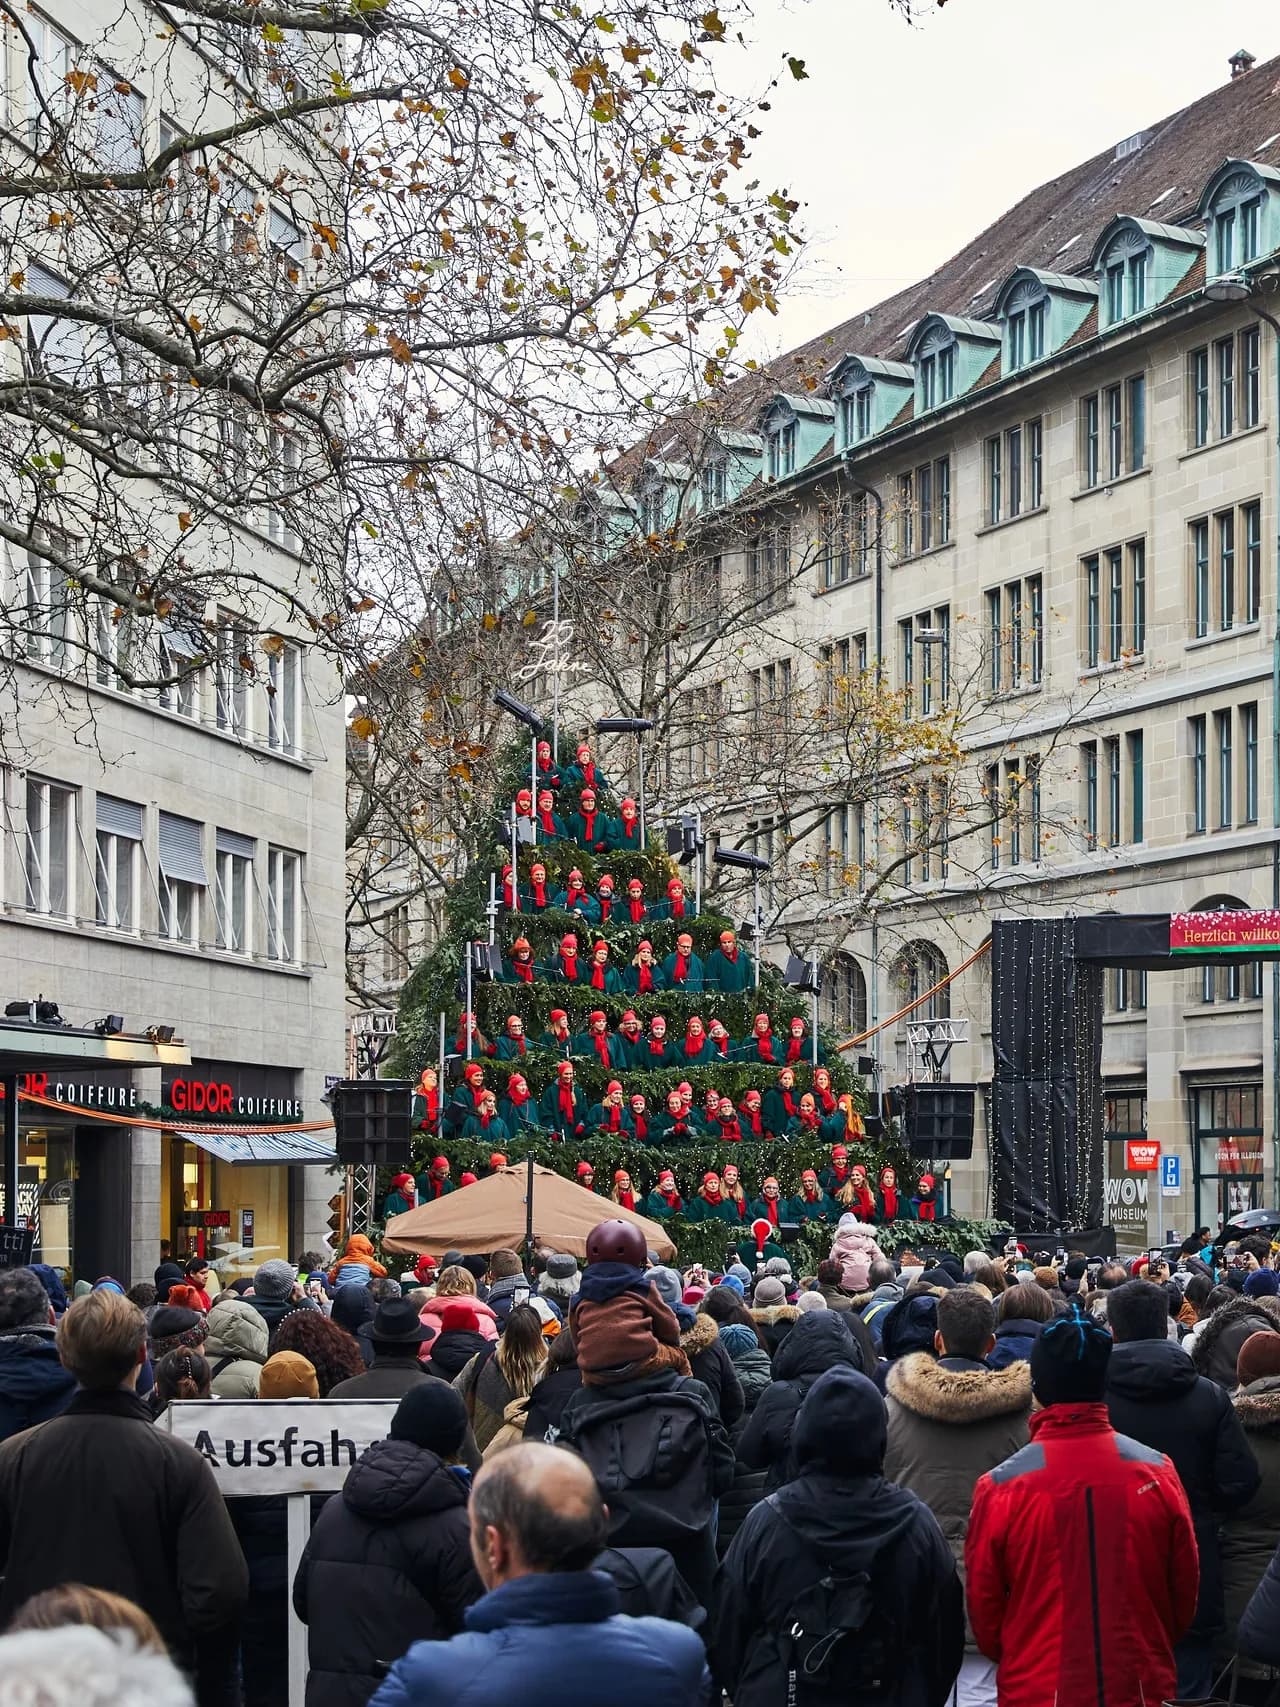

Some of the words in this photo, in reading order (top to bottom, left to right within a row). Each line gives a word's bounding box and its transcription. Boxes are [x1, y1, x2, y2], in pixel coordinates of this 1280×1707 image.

[540, 619, 574, 646] 25
[1184, 929, 1236, 943] Herzlich
[56, 1083, 136, 1107] COIFFURE
[171, 1079, 233, 1114] GIDOR
[238, 1097, 300, 1118] COIFFURE
[1130, 1146, 1157, 1157] WOW
[1167, 1158, 1176, 1174] P
[204, 1212, 229, 1227] GIDOR
[1110, 1208, 1148, 1221] MUSEUM
[194, 1426, 382, 1468] Ausfah
